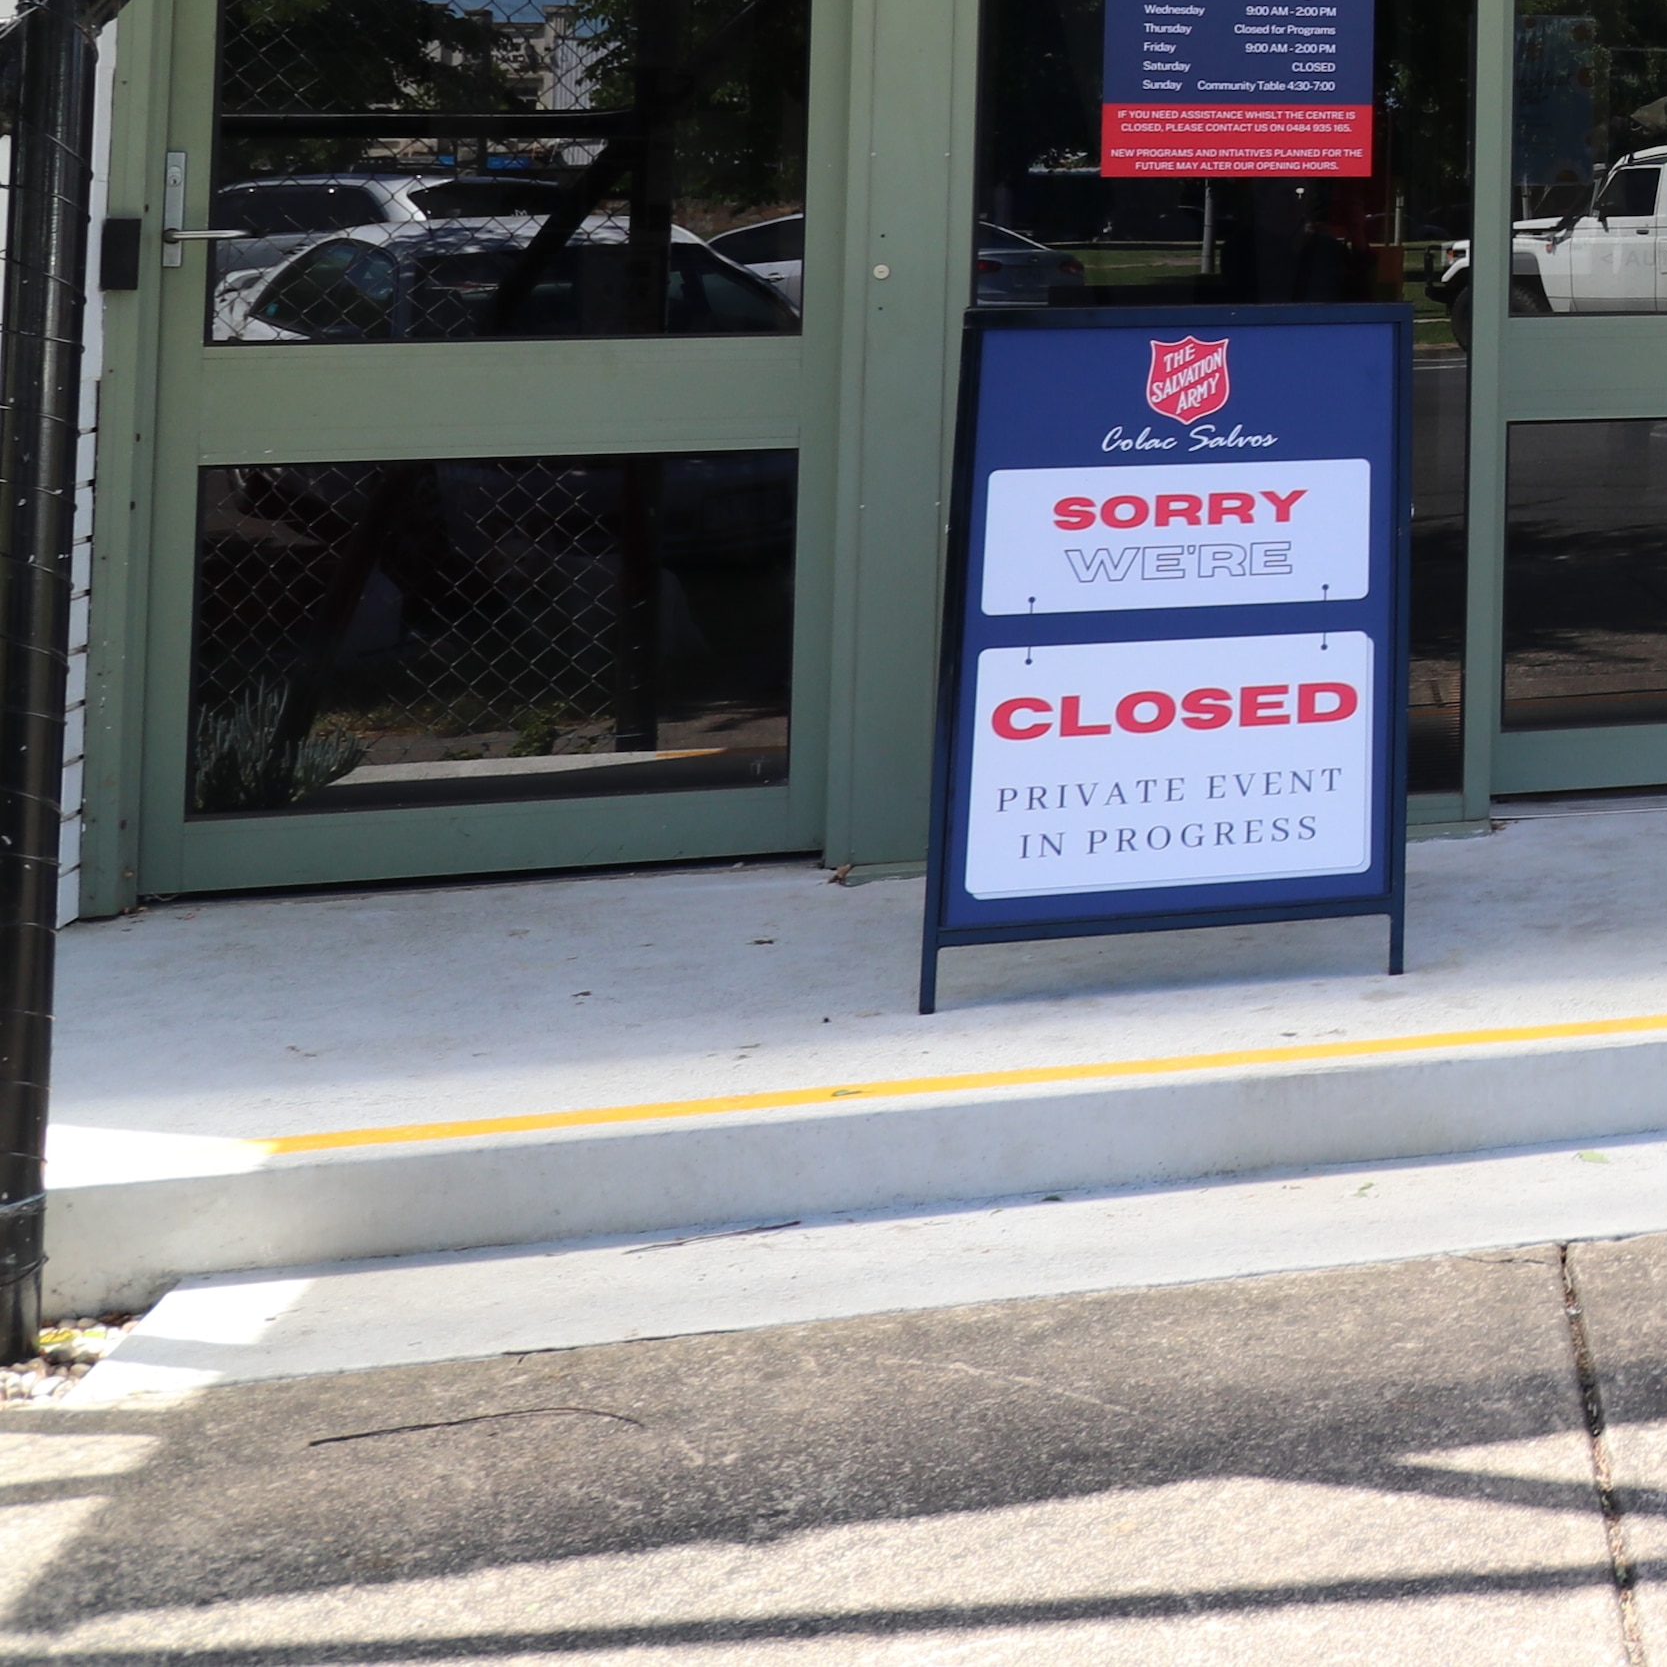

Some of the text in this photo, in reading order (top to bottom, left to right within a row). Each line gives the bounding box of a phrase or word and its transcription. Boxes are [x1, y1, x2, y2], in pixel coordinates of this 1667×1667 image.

[1144, 5, 1205, 16] Wednesday
[1246, 6, 1269, 16] 9:00
[1271, 6, 1288, 16] AM
[1296, 7, 1318, 16] 2:00
[1320, 7, 1336, 16] PM
[1144, 23, 1335, 36] Thursday Closed for Programs
[1144, 42, 1176, 54] Friday
[1245, 43, 1268, 53] 9:00
[1270, 43, 1287, 53] AM
[1295, 44, 1317, 53] 2:00
[1319, 44, 1335, 54] PM
[1143, 61, 1335, 73] Saturday CLOSED
[1143, 80, 1335, 92] Sunday Community Table 4:30-7:00
[1118, 111, 1355, 119] IF YOU NEED ASSISTANCE WHISLT THE CENTRE IS
[1121, 123, 1352, 132] CLOSED, PLEASE CONTACT US ON 0484 935 165.
[1111, 149, 1362, 157] NEW PROGRAMS AND INTIATIVES PLANNED FOR THE
[1135, 162, 1338, 170] FUTURE MAY ALTER OUR OPENING HOURS.
[1164, 344, 1195, 372] THE
[1152, 348, 1222, 403] SALVATION
[1176, 373, 1219, 414] ARMY
[1102, 424, 1277, 451] Colac Salvos
[1053, 490, 1308, 531] SORRY
[1064, 541, 1292, 583] WE'RE
[991, 682, 1358, 741] CLOSED
[996, 767, 1342, 812] PRIVATE EVENT
[1020, 816, 1317, 859] IN PROGRESS
